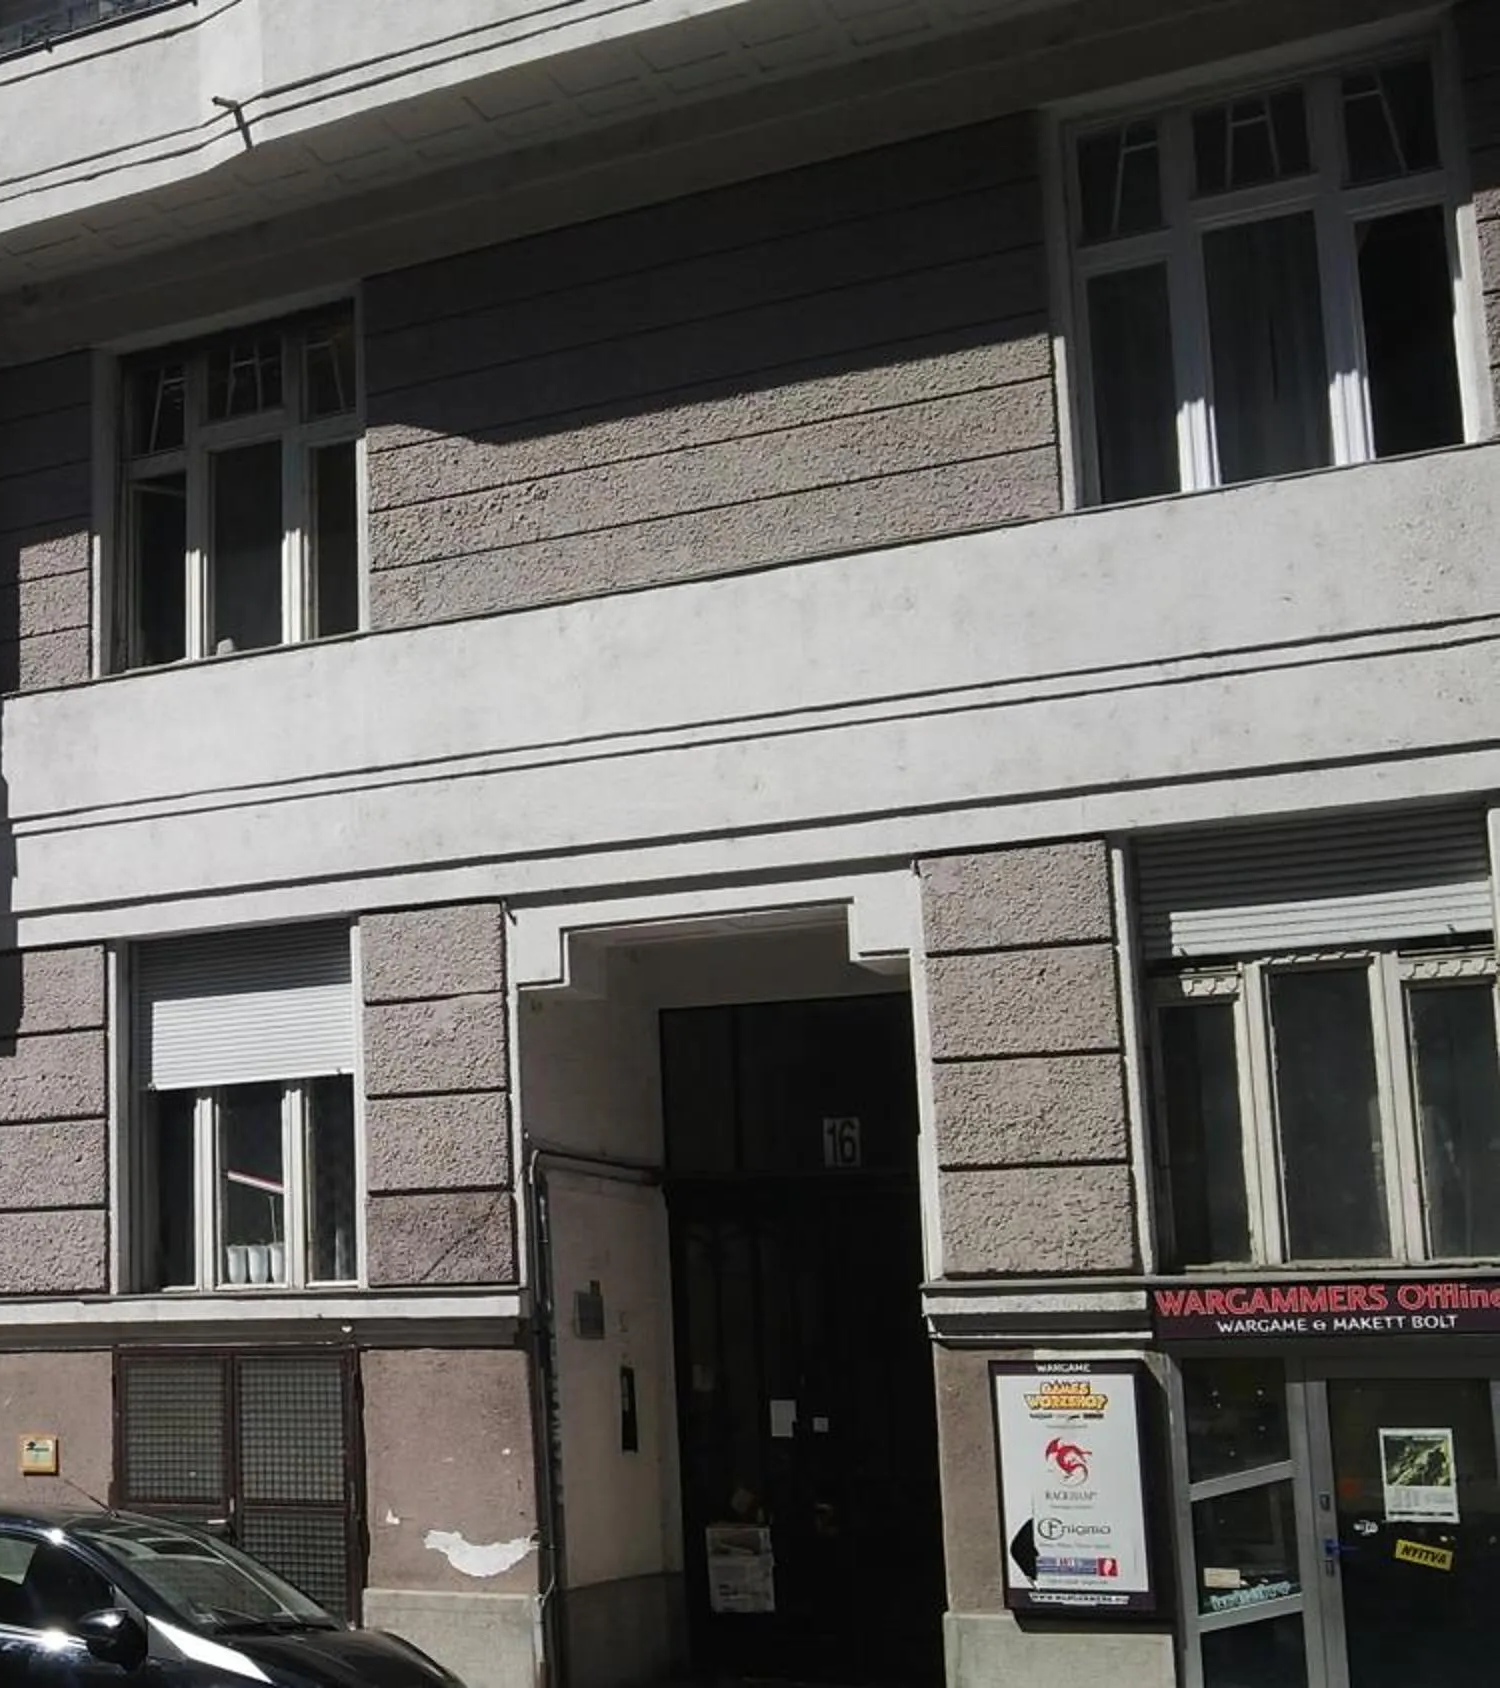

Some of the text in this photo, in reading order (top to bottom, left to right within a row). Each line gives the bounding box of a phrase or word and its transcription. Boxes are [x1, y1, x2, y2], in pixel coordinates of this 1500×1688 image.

[827, 1120, 856, 1163] 16
[1154, 1284, 1389, 1317] WARGAMMERS
[1216, 1318, 1307, 1333] WARGAME
[1333, 1316, 1406, 1332] MAKETT
[1411, 1315, 1458, 1329] BOLT
